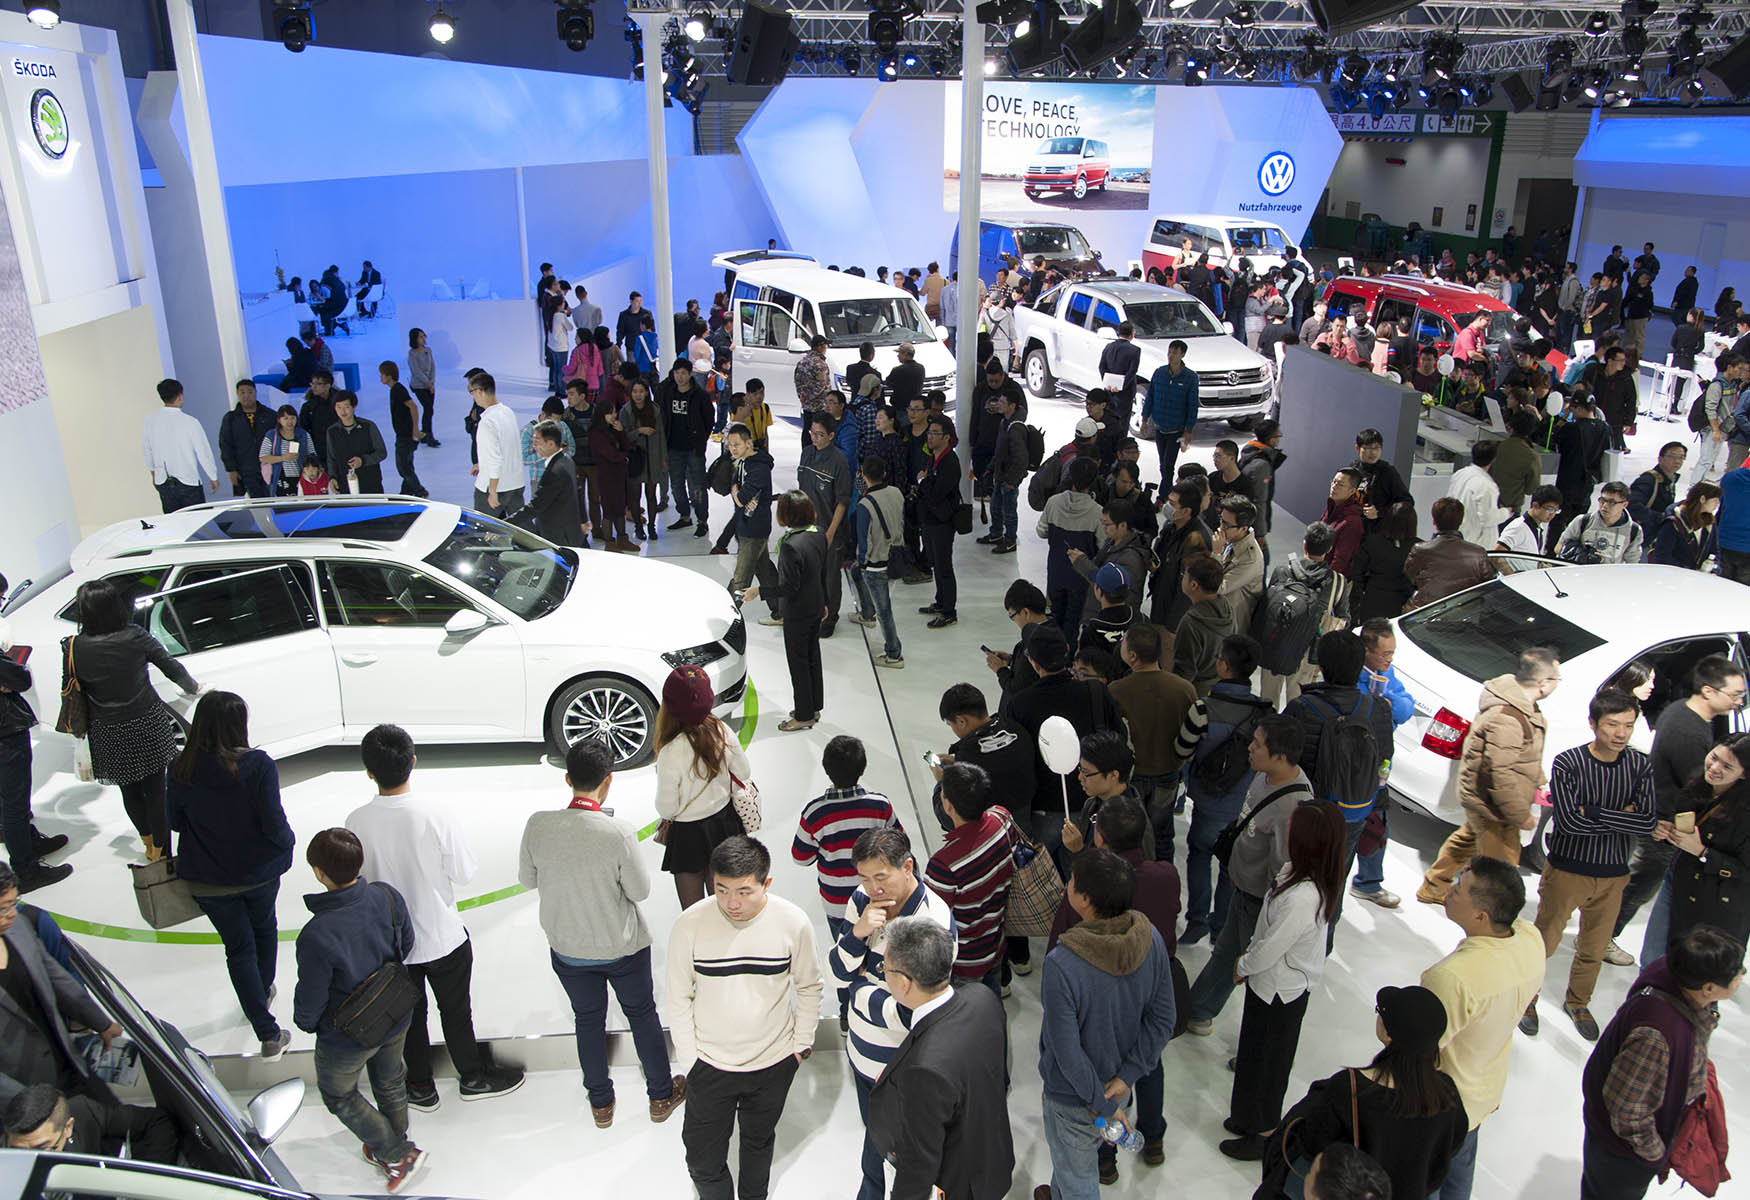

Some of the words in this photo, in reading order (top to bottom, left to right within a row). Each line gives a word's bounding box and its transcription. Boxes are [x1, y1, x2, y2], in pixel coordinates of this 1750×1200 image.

[14, 58, 57, 78] ŠKODA
[982, 94, 1027, 119] OVE,
[1033, 100, 1079, 123] PEACE,
[982, 119, 1081, 139] ECHNOLOGY
[1239, 202, 1303, 214] Nutzfahrzeuge
